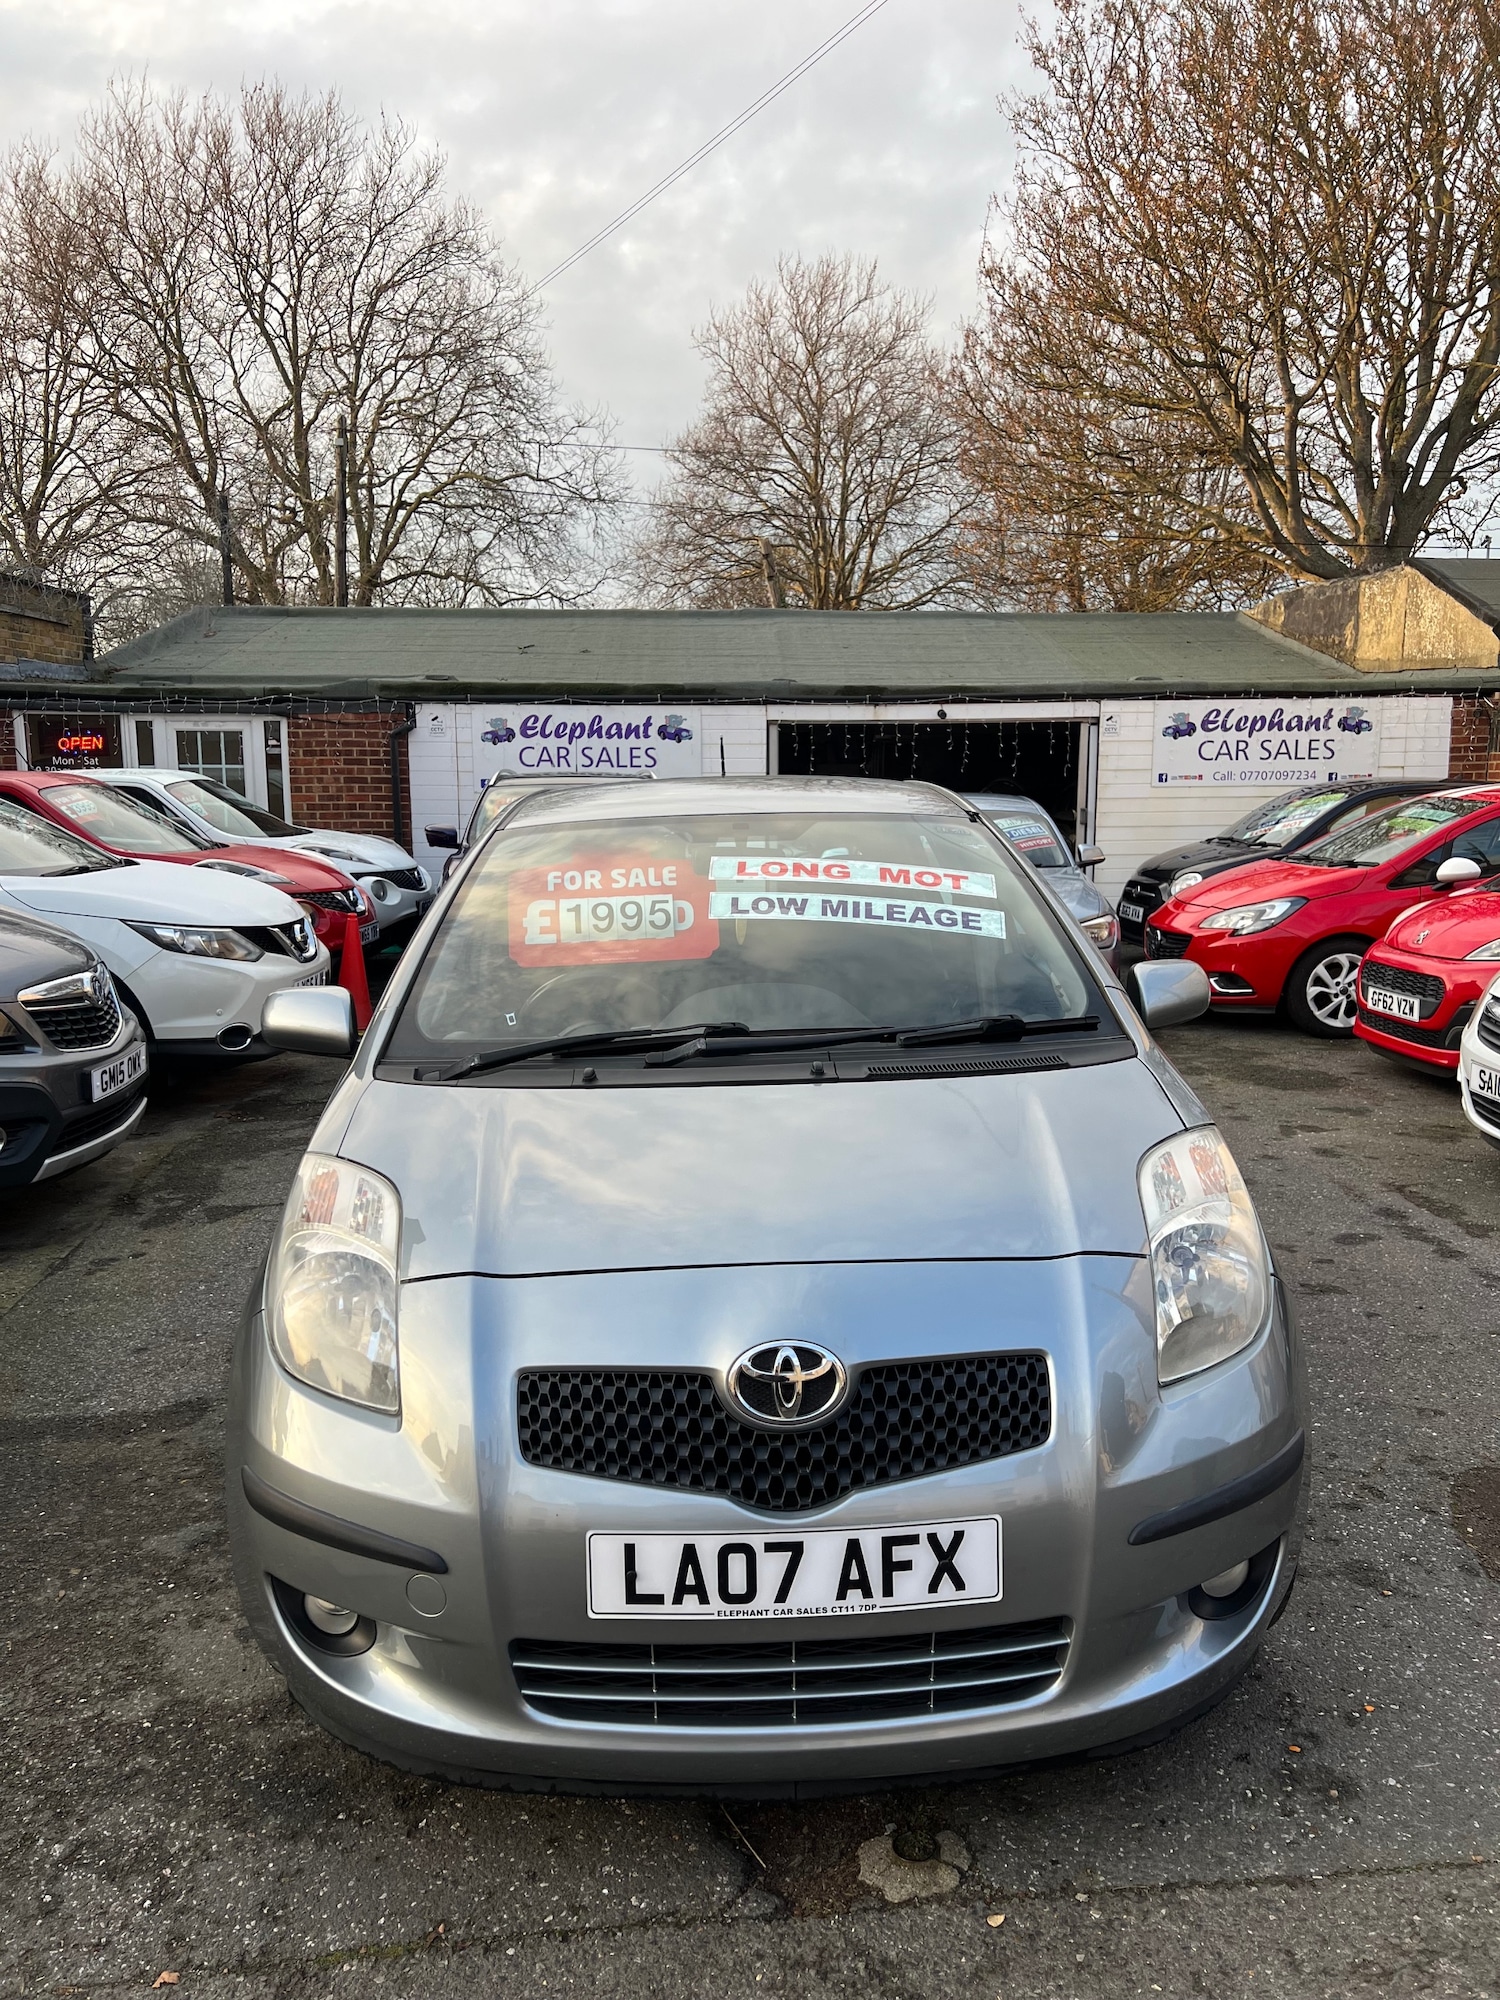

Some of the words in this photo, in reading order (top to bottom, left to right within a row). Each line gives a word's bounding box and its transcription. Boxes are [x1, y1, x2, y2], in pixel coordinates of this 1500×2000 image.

[519, 714, 653, 745] Elephant
[1200, 707, 1334, 738] Elephant
[57, 736, 104, 751] OPEN
[1198, 739, 1250, 761] CAR
[1259, 738, 1336, 761] SALES
[52, 756, 75, 766] Mon
[83, 756, 99, 766] Sat
[519, 746, 571, 769] CAR
[581, 746, 658, 769] SALES
[1212, 770, 1236, 782] Call:
[1240, 769, 1317, 782] 07707097234
[1012, 826, 1044, 837] DIESEL
[547, 869, 603, 891] FOR
[610, 865, 678, 888] SALE
[736, 861, 851, 879] LONG
[879, 867, 969, 890] MOT
[730, 896, 809, 915] LOW
[821, 898, 983, 931] MILEAGE
[1371, 990, 1394, 1012] GF62
[101, 1060, 125, 1092] GM15
[623, 1539, 804, 1606] LA07
[835, 1529, 967, 1602] AFX
[717, 1609, 770, 1618] ELEPHANT
[773, 1608, 793, 1616] CAR
[796, 1606, 828, 1615] SALES
[831, 1605, 855, 1614] CT11
[858, 1603, 877, 1612] 7DP
